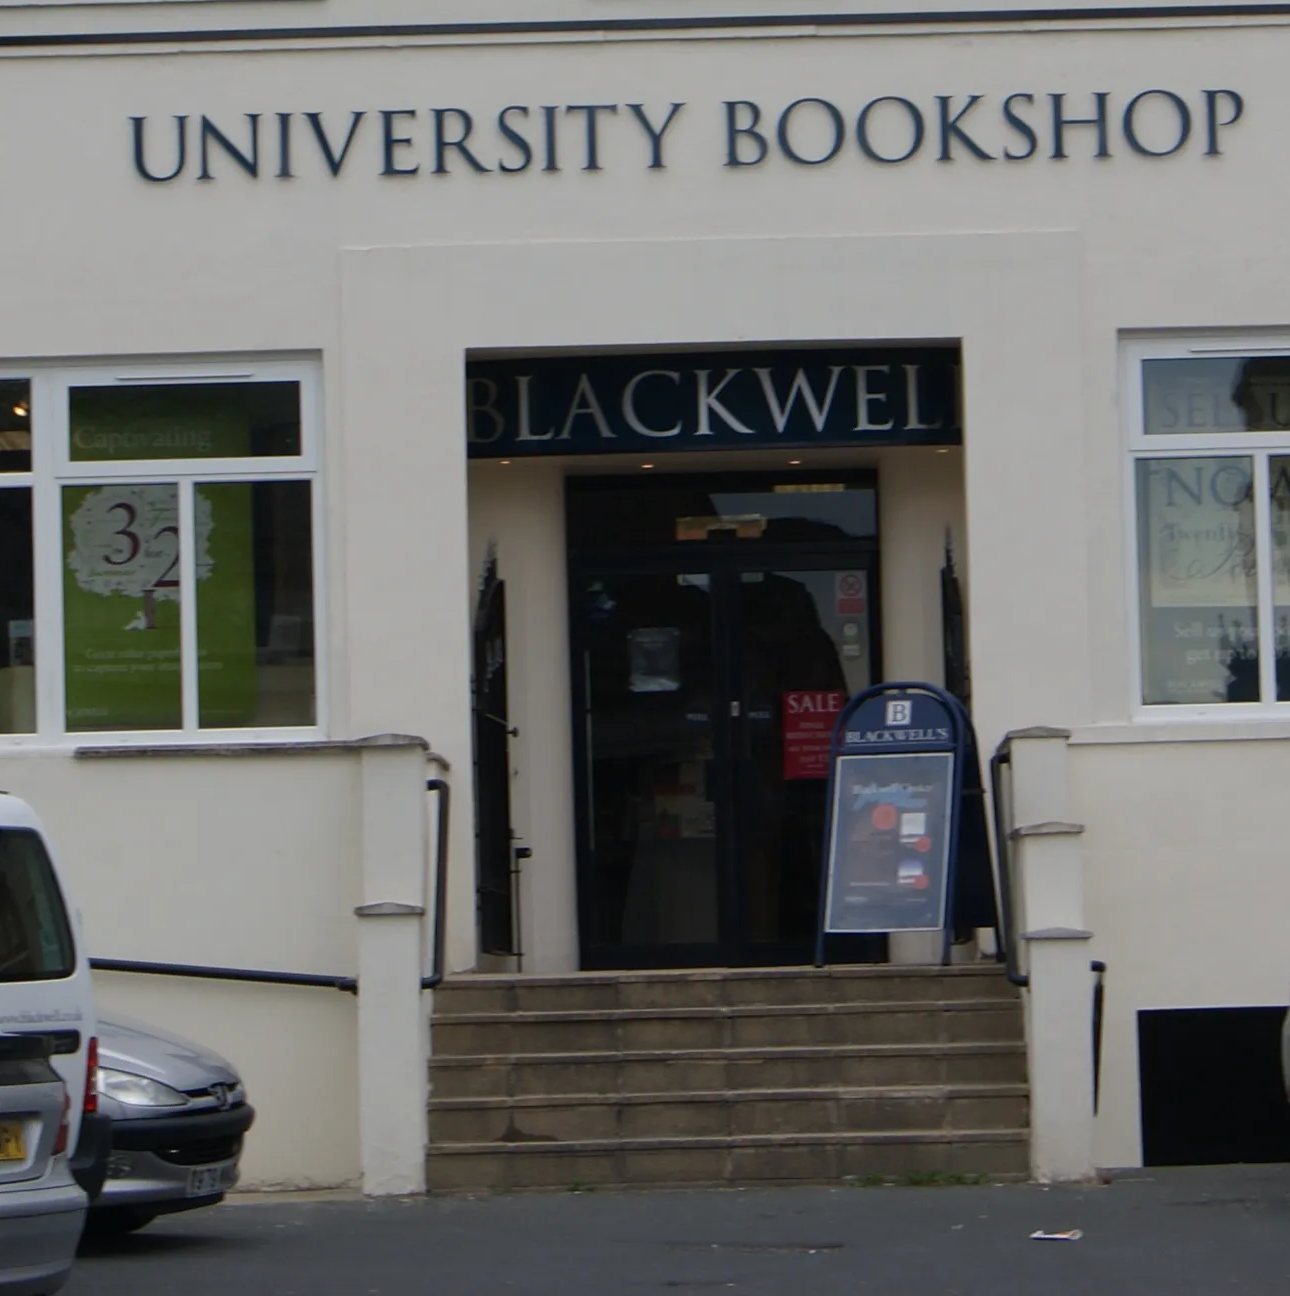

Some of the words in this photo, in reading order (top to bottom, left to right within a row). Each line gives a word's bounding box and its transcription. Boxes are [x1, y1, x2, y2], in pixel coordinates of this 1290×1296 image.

[125, 103, 686, 183] UNIVERSITY
[723, 89, 1247, 169] BOOKSHOP
[73, 426, 213, 453] Captivating
[101, 502, 142, 566] 3
[787, 693, 841, 714] SALE
[845, 728, 950, 743] BLACKWELL'S
